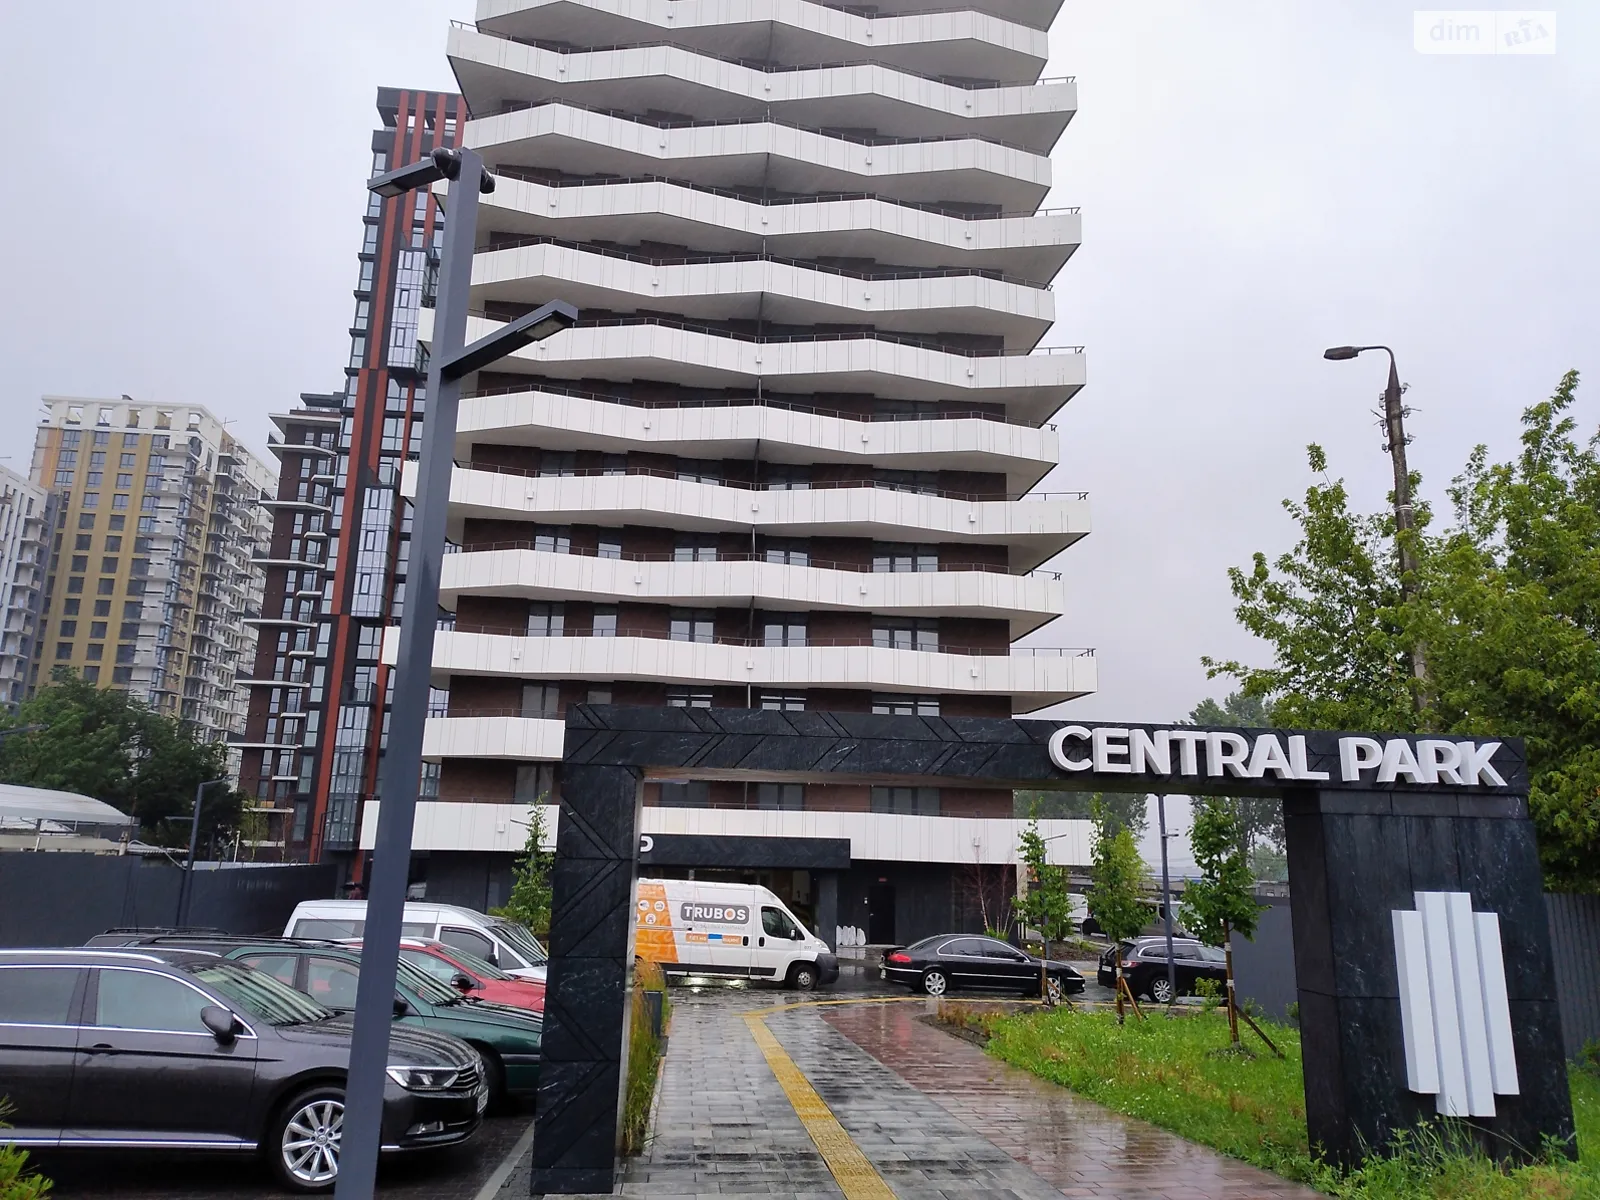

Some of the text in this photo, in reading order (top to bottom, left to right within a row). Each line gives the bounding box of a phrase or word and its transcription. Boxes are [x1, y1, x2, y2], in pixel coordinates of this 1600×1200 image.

[1048, 725, 1508, 788] CENTRAL PARK
[684, 906, 746, 921] TRUBOS
